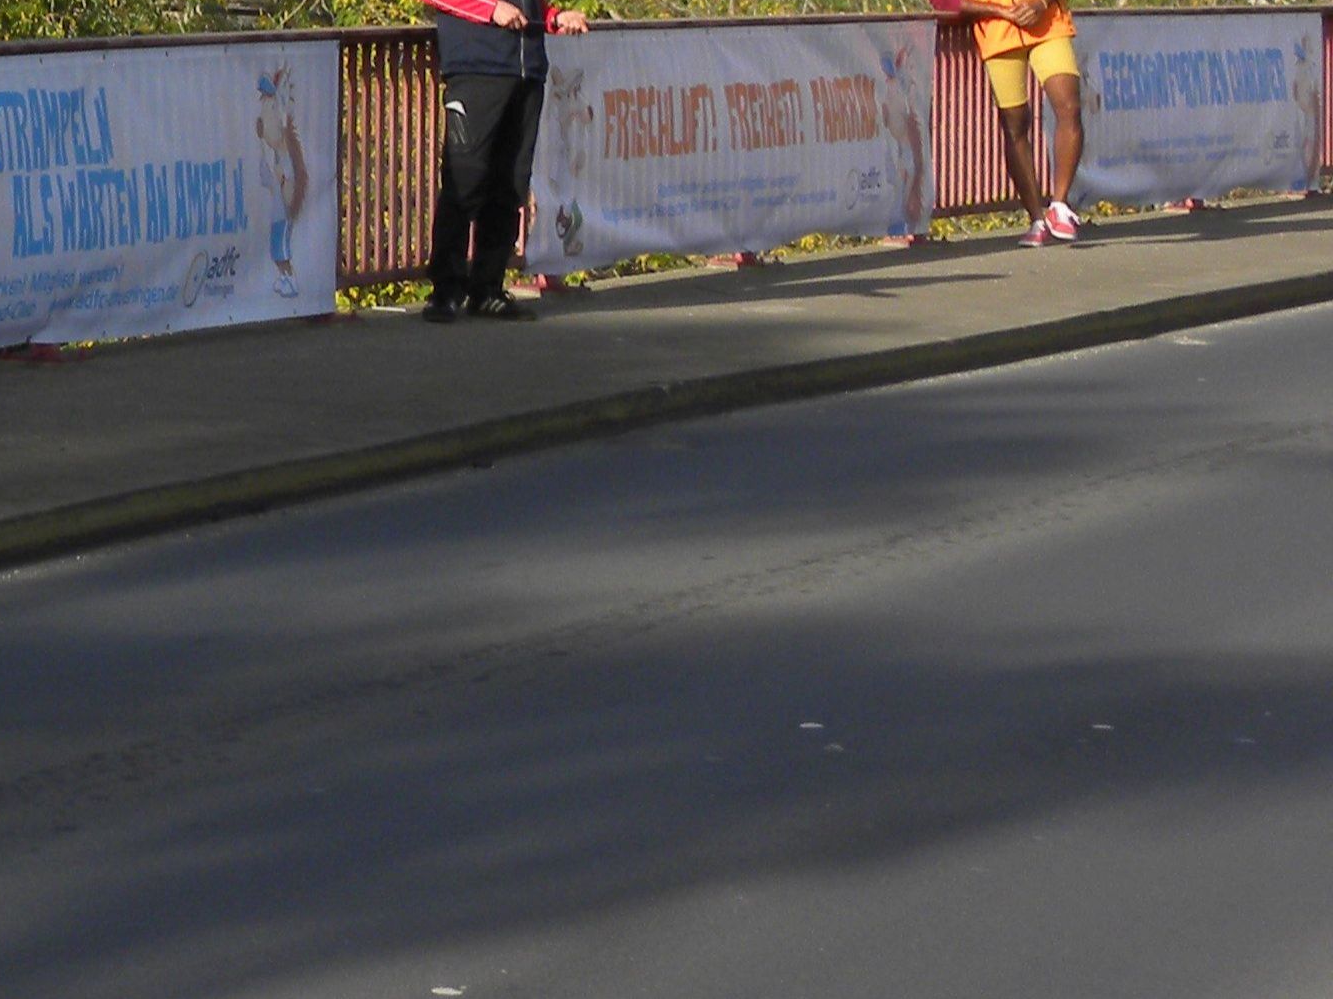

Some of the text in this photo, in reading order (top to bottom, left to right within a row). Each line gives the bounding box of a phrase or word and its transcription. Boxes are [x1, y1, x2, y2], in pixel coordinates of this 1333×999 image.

[12, 173, 54, 258] ALS
[56, 167, 141, 252] WARTEN
[144, 162, 171, 243] AN
